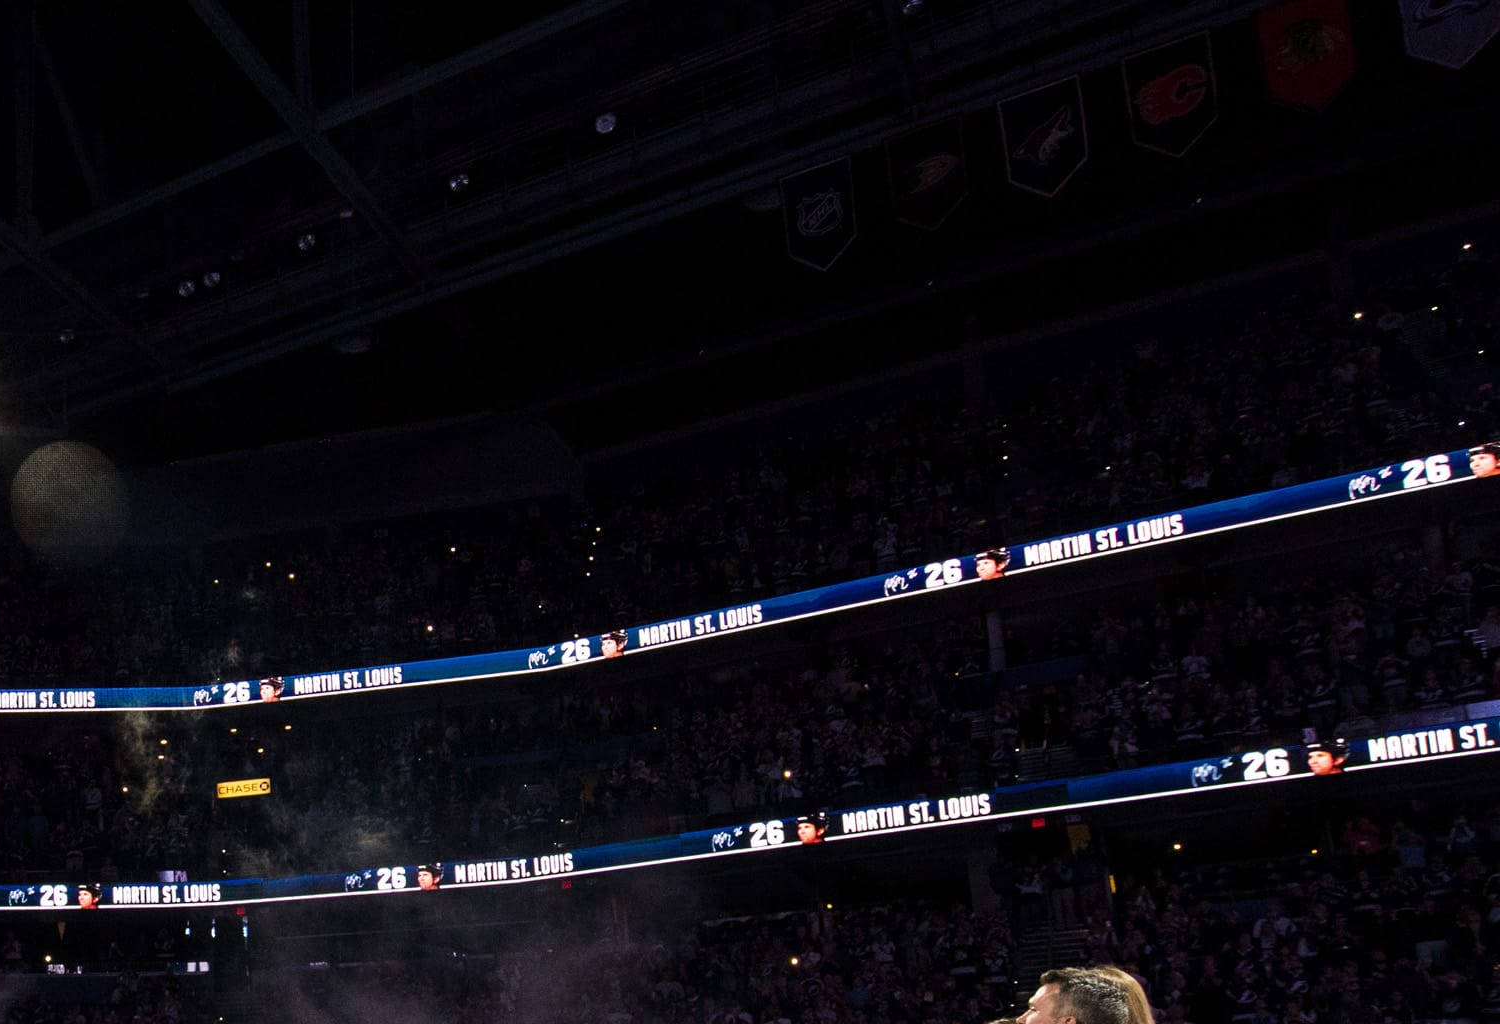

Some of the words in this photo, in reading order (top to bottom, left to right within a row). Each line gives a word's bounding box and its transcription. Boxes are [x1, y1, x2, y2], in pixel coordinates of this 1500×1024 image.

[1401, 454, 1451, 489] 26
[924, 558, 962, 589] 26
[1023, 533, 1092, 567] MARTIN
[1096, 527, 1123, 551] ST.
[1126, 514, 1184, 545] LOUIS
[560, 637, 591, 665] 26
[638, 623, 692, 648] MARTIN
[694, 614, 715, 636] ST.
[719, 604, 763, 631] LOUIS
[39, 691, 56, 708] ST.
[60, 690, 96, 708] LOUIS
[223, 681, 250, 705] 26
[294, 674, 341, 695] MARTIN
[343, 671, 362, 690] ST.
[365, 667, 403, 688] LOUIS
[1241, 748, 1291, 781] 26
[1368, 731, 1455, 762] MARTIN
[1458, 723, 1495, 750] ST.
[218, 783, 258, 795] CHASE
[749, 819, 785, 848] 26
[842, 805, 905, 834] MARTIN
[909, 801, 934, 825] ST.
[938, 793, 992, 823] LOUIS
[376, 866, 407, 891] 26
[454, 861, 507, 884] MARTIN
[510, 858, 530, 879] ST.
[533, 852, 574, 876] LOUIS
[39, 885, 68, 907] 26
[112, 886, 159, 904] MARTIN
[162, 885, 181, 903] ST.
[184, 884, 221, 902] LOUIS
